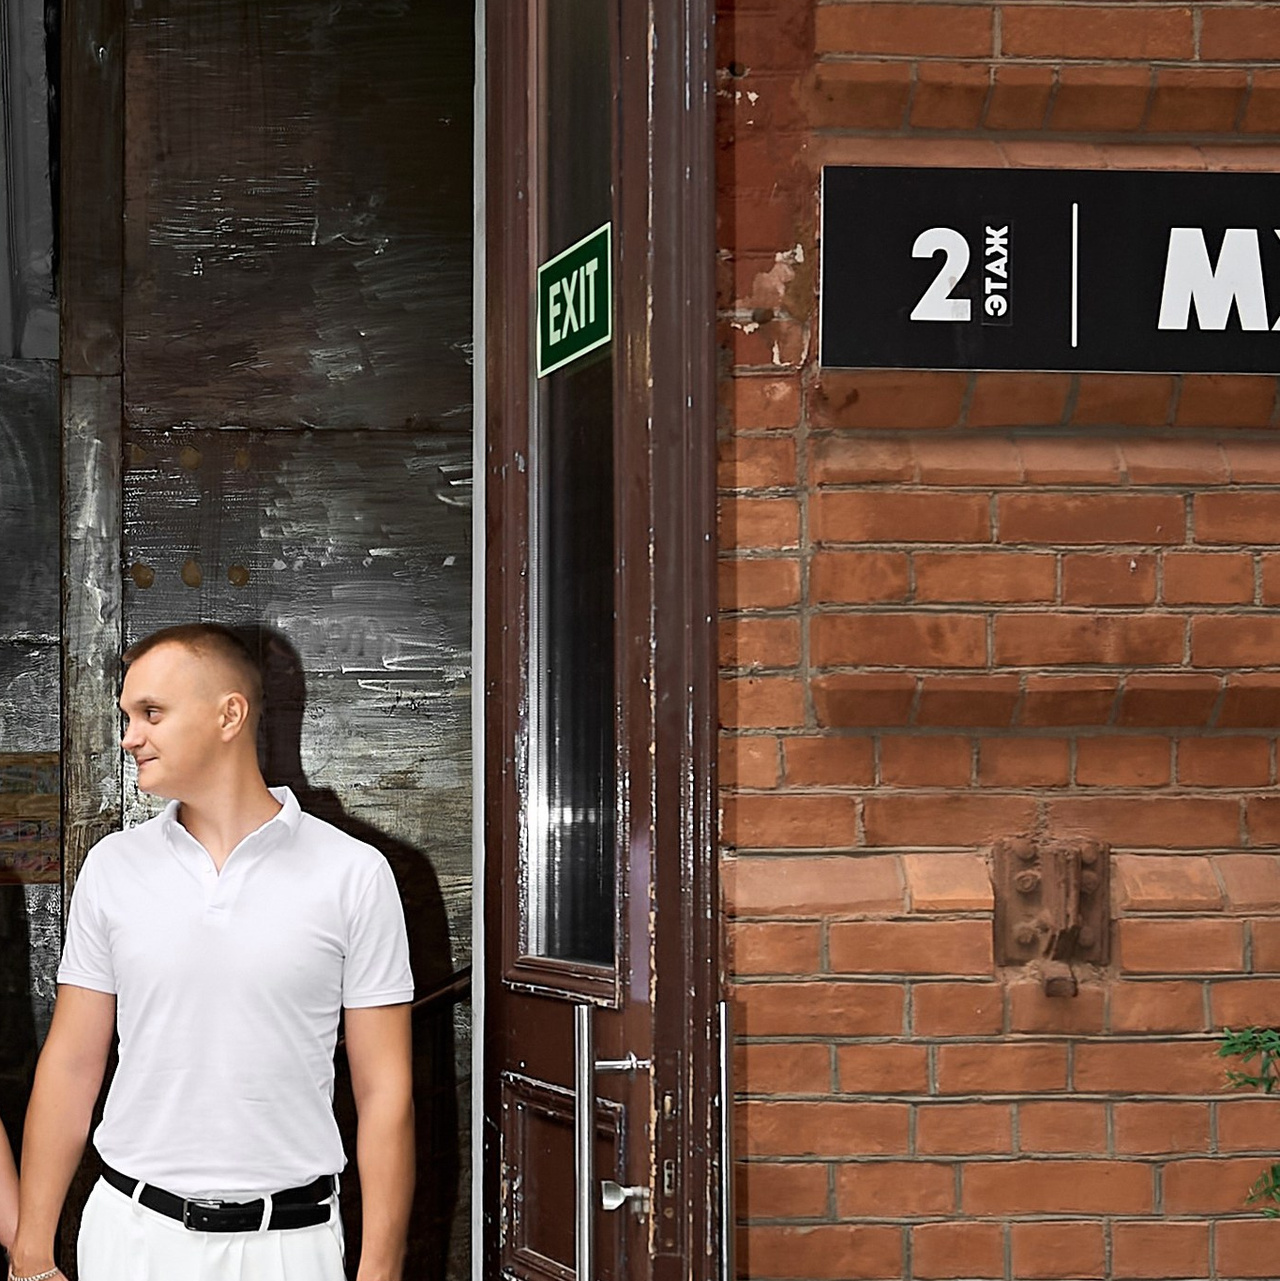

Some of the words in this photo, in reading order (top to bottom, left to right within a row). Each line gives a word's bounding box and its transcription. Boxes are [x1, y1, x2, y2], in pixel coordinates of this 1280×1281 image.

[549, 257, 598, 346] EXIT
[910, 227, 971, 321] 2
[985, 225, 1009, 317] ЭТАЖ
